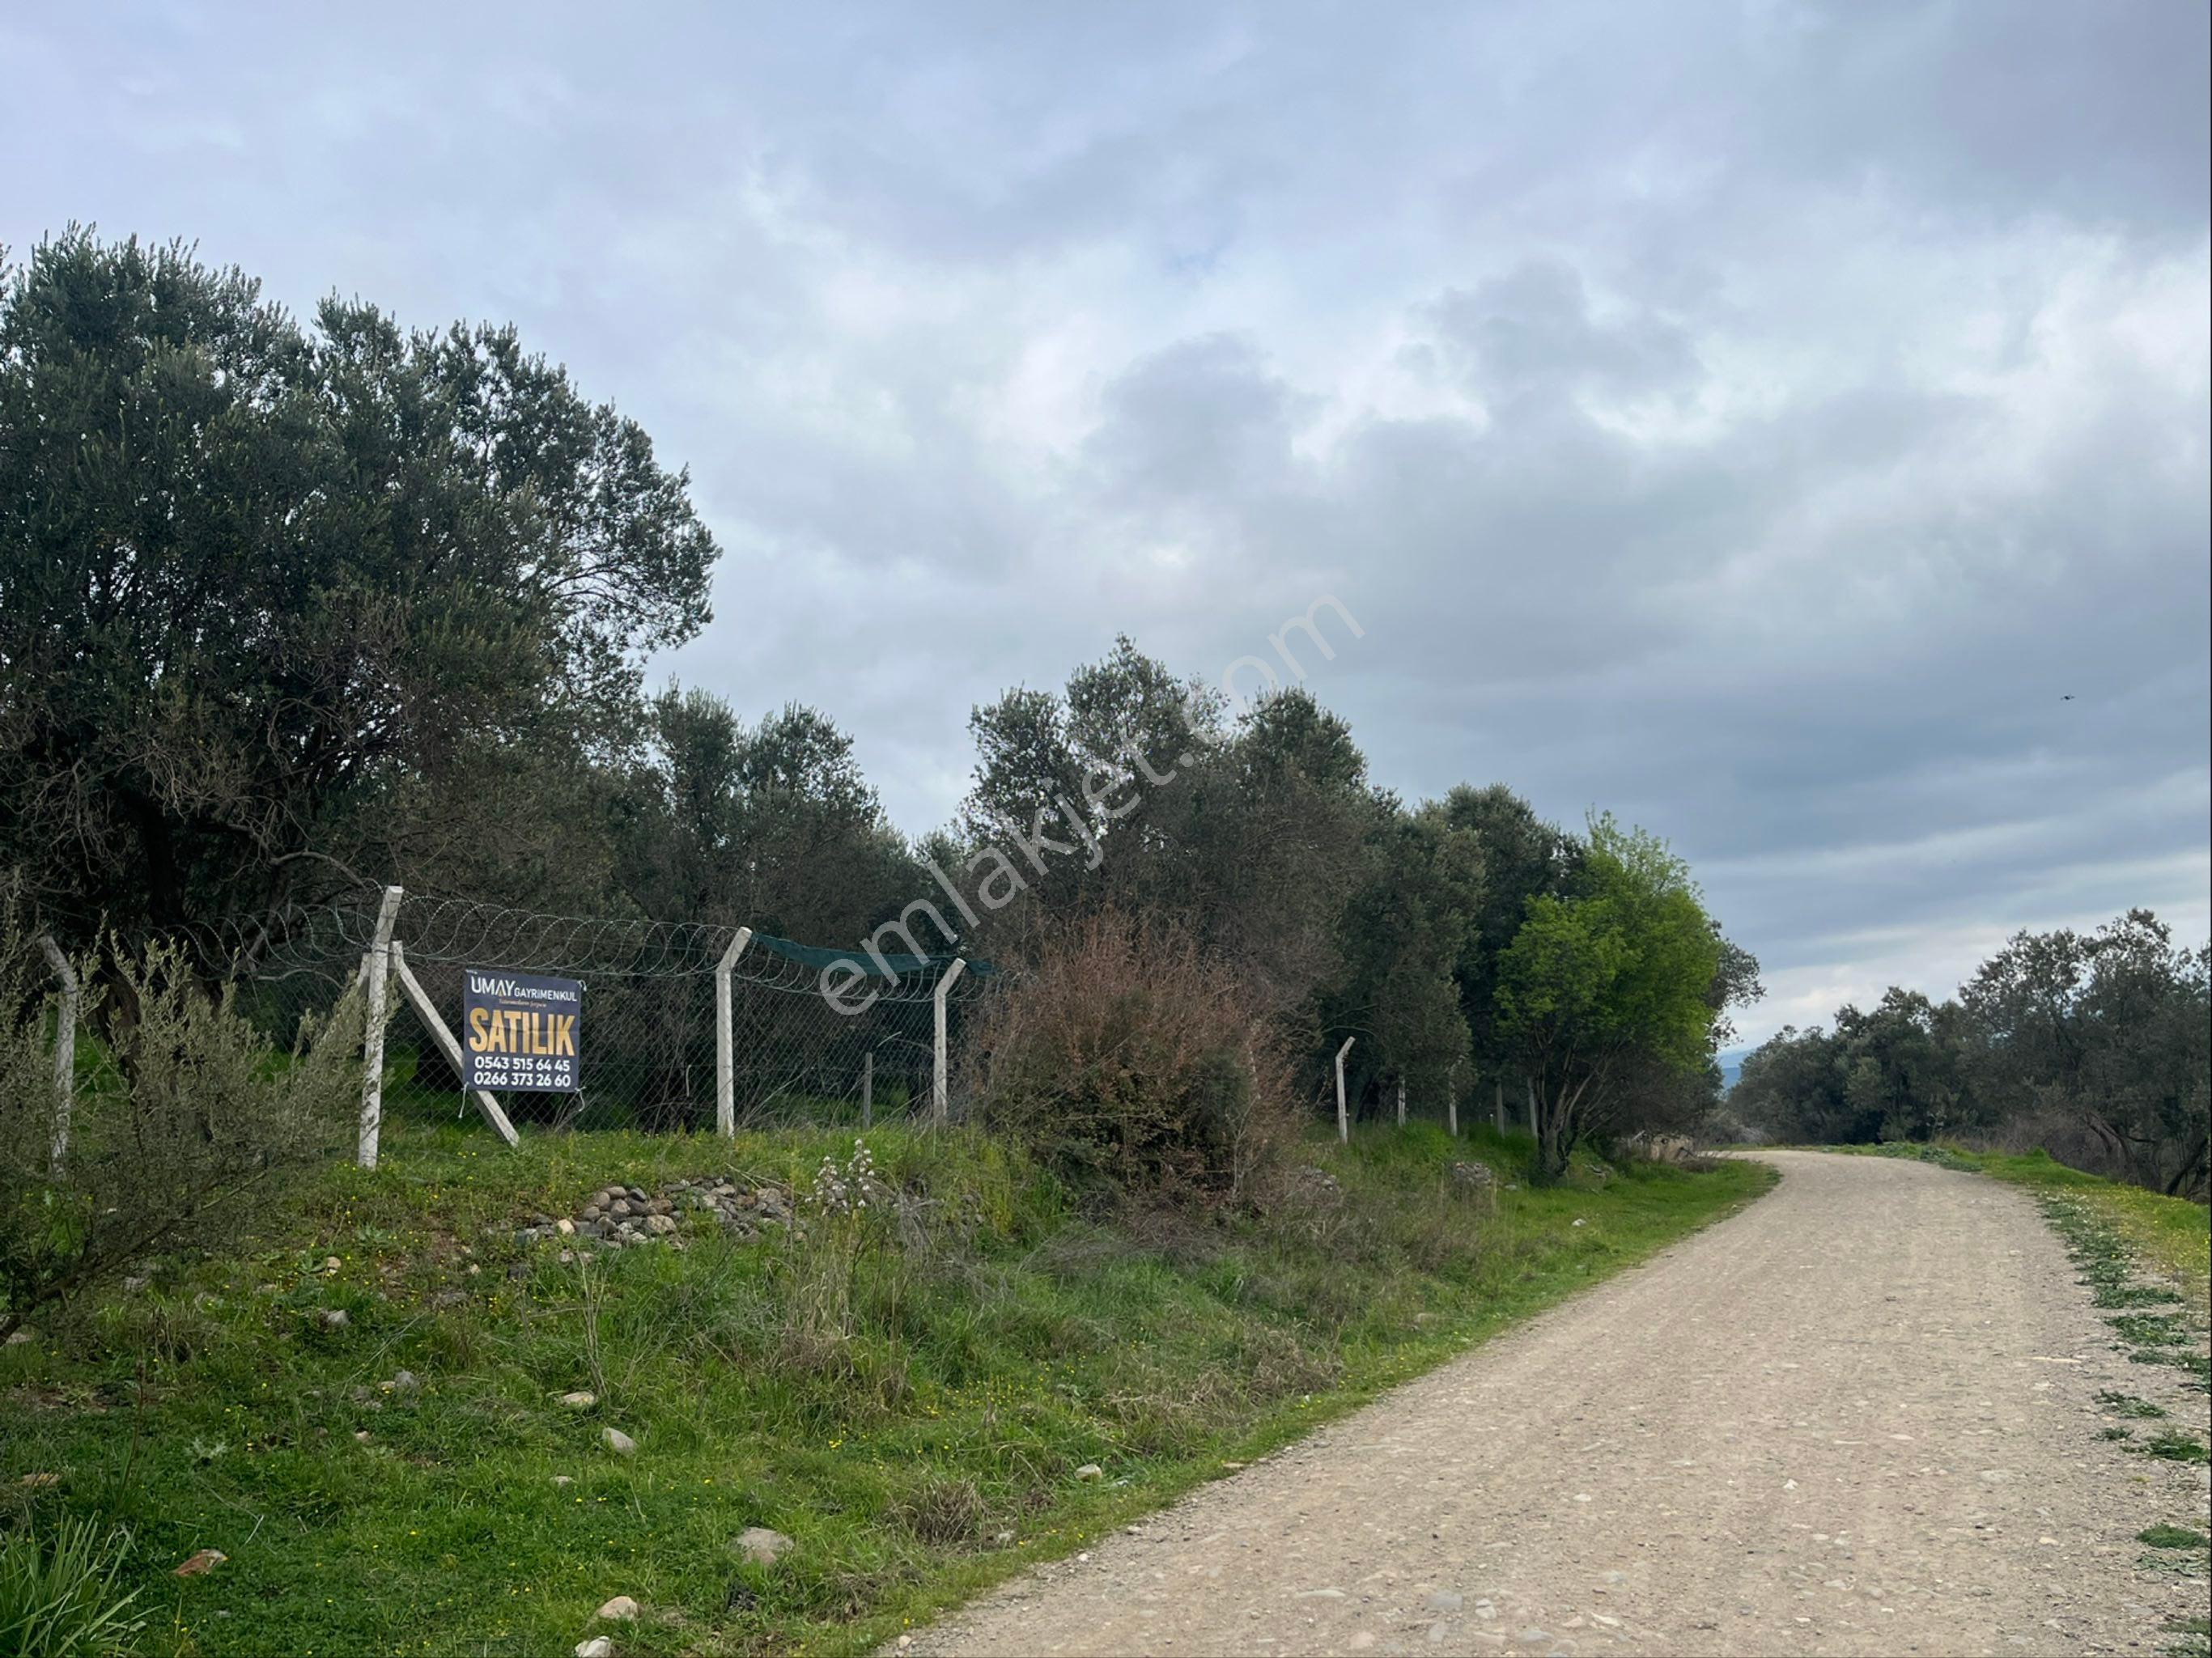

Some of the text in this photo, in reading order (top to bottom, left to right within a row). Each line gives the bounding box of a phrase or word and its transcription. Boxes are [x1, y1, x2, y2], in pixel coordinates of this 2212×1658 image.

[471, 976, 516, 996] UMAY
[469, 1007, 575, 1056] SATILIK
[474, 1056, 570, 1071] 0543 515 64 45
[473, 1071, 571, 1087] 0266 373 26 60
